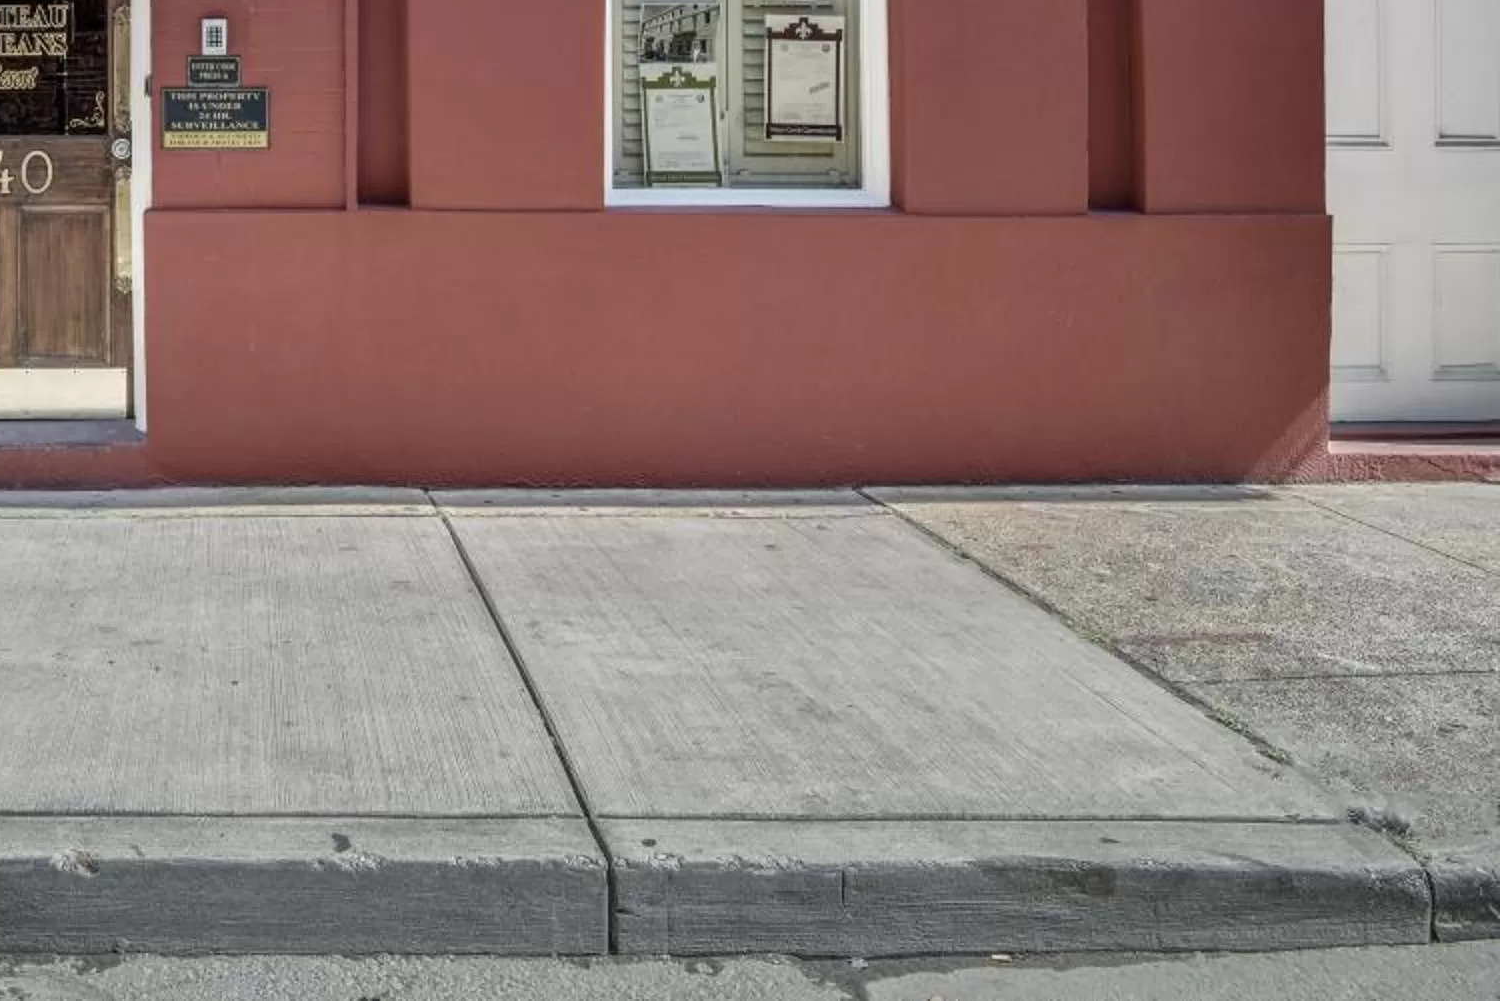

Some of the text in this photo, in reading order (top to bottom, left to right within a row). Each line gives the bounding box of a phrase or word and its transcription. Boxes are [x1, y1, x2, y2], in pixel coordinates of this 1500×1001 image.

[199, 92, 261, 101] PROPERTY
[200, 102, 241, 110] UNDER
[171, 121, 260, 130] SURVEILLANCE
